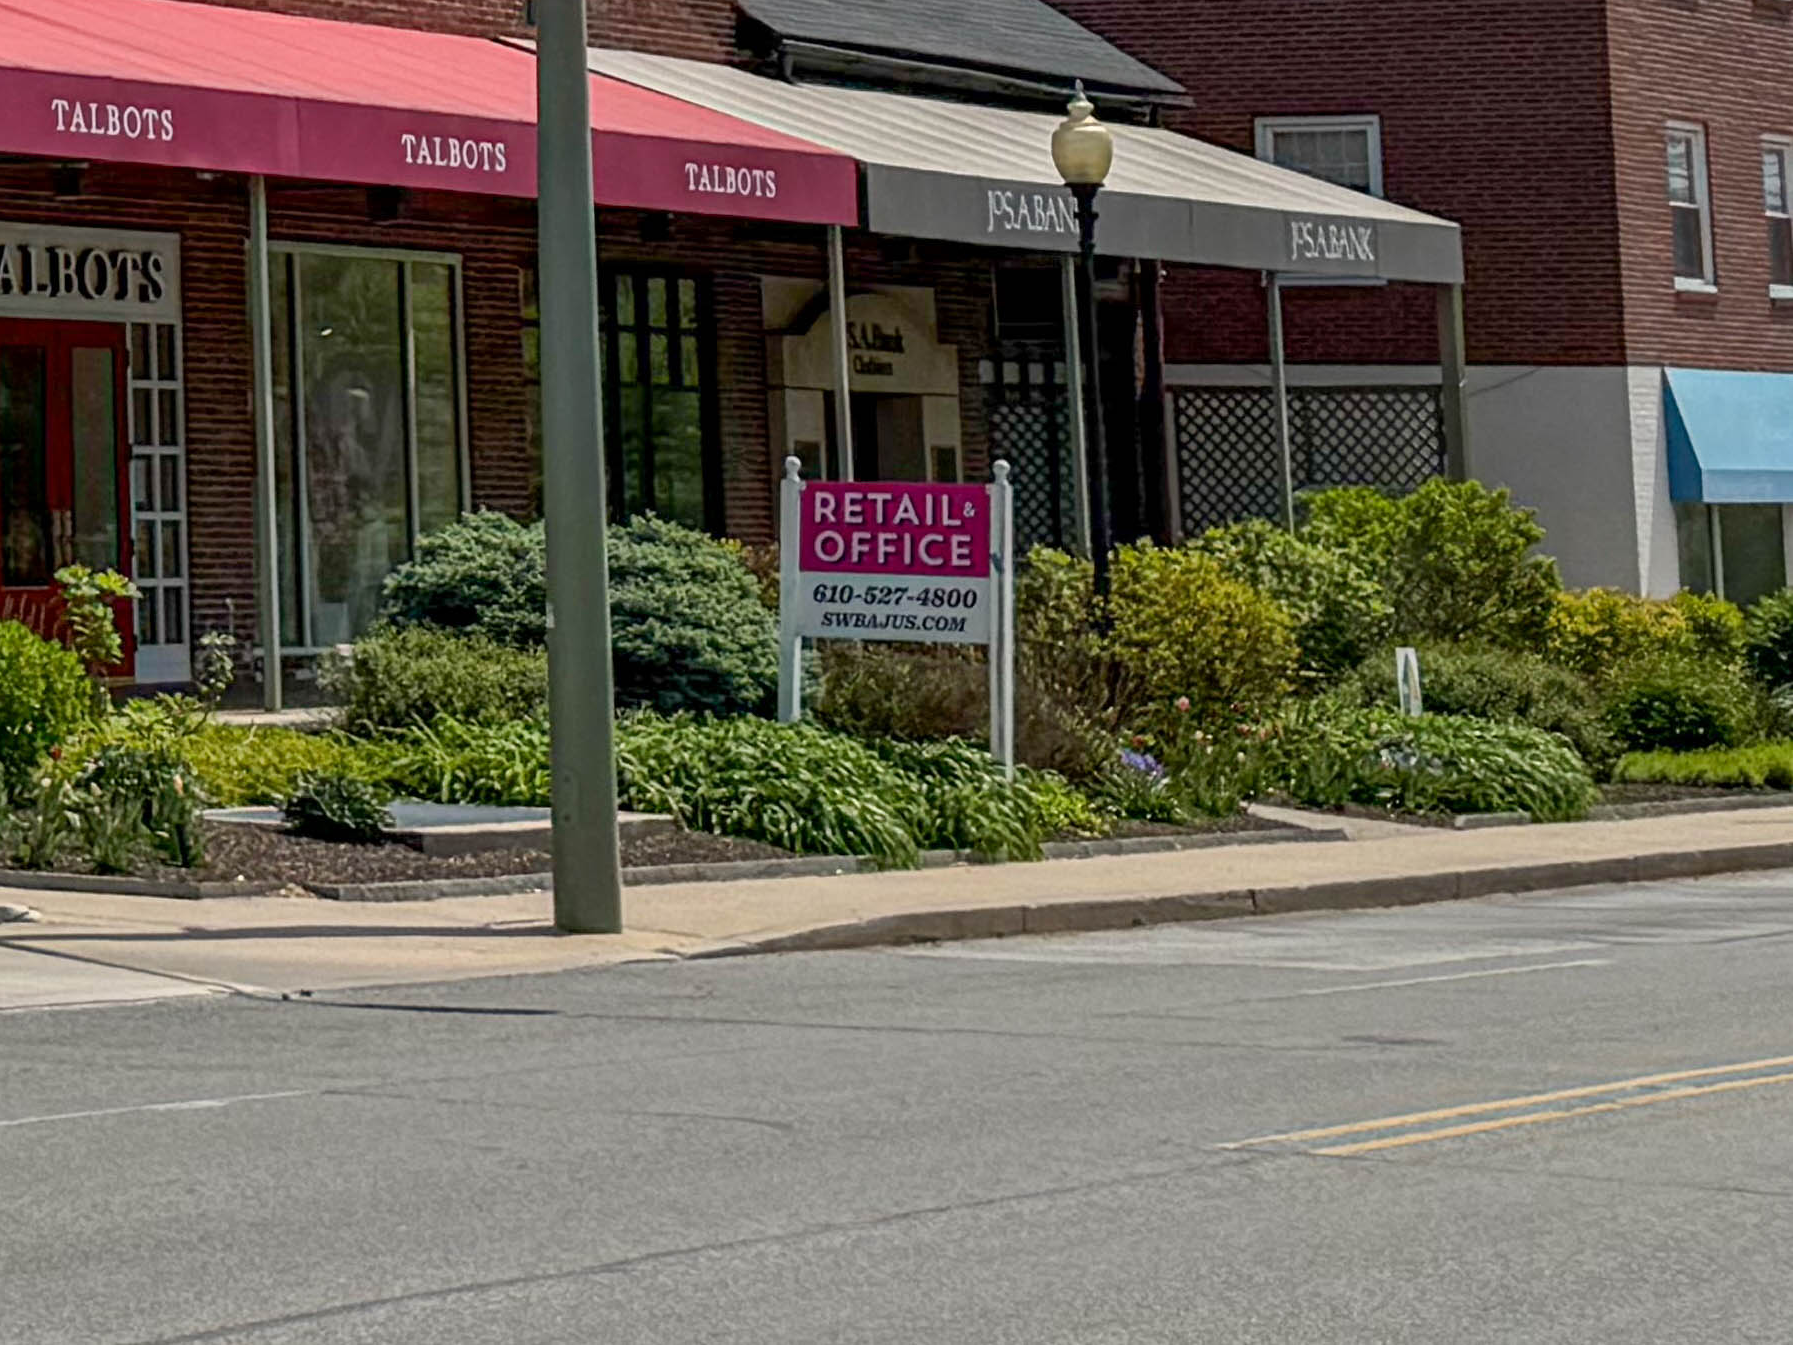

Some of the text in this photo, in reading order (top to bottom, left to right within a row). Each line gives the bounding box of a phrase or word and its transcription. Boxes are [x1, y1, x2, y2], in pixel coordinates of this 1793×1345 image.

[51, 99, 174, 142] TALBOTS
[401, 134, 507, 172] TALBOTS
[685, 163, 777, 198] TALBOTS
[813, 492, 976, 526] RETAIL &
[814, 530, 972, 566] OFFICE
[813, 584, 978, 609] 610-527-4800
